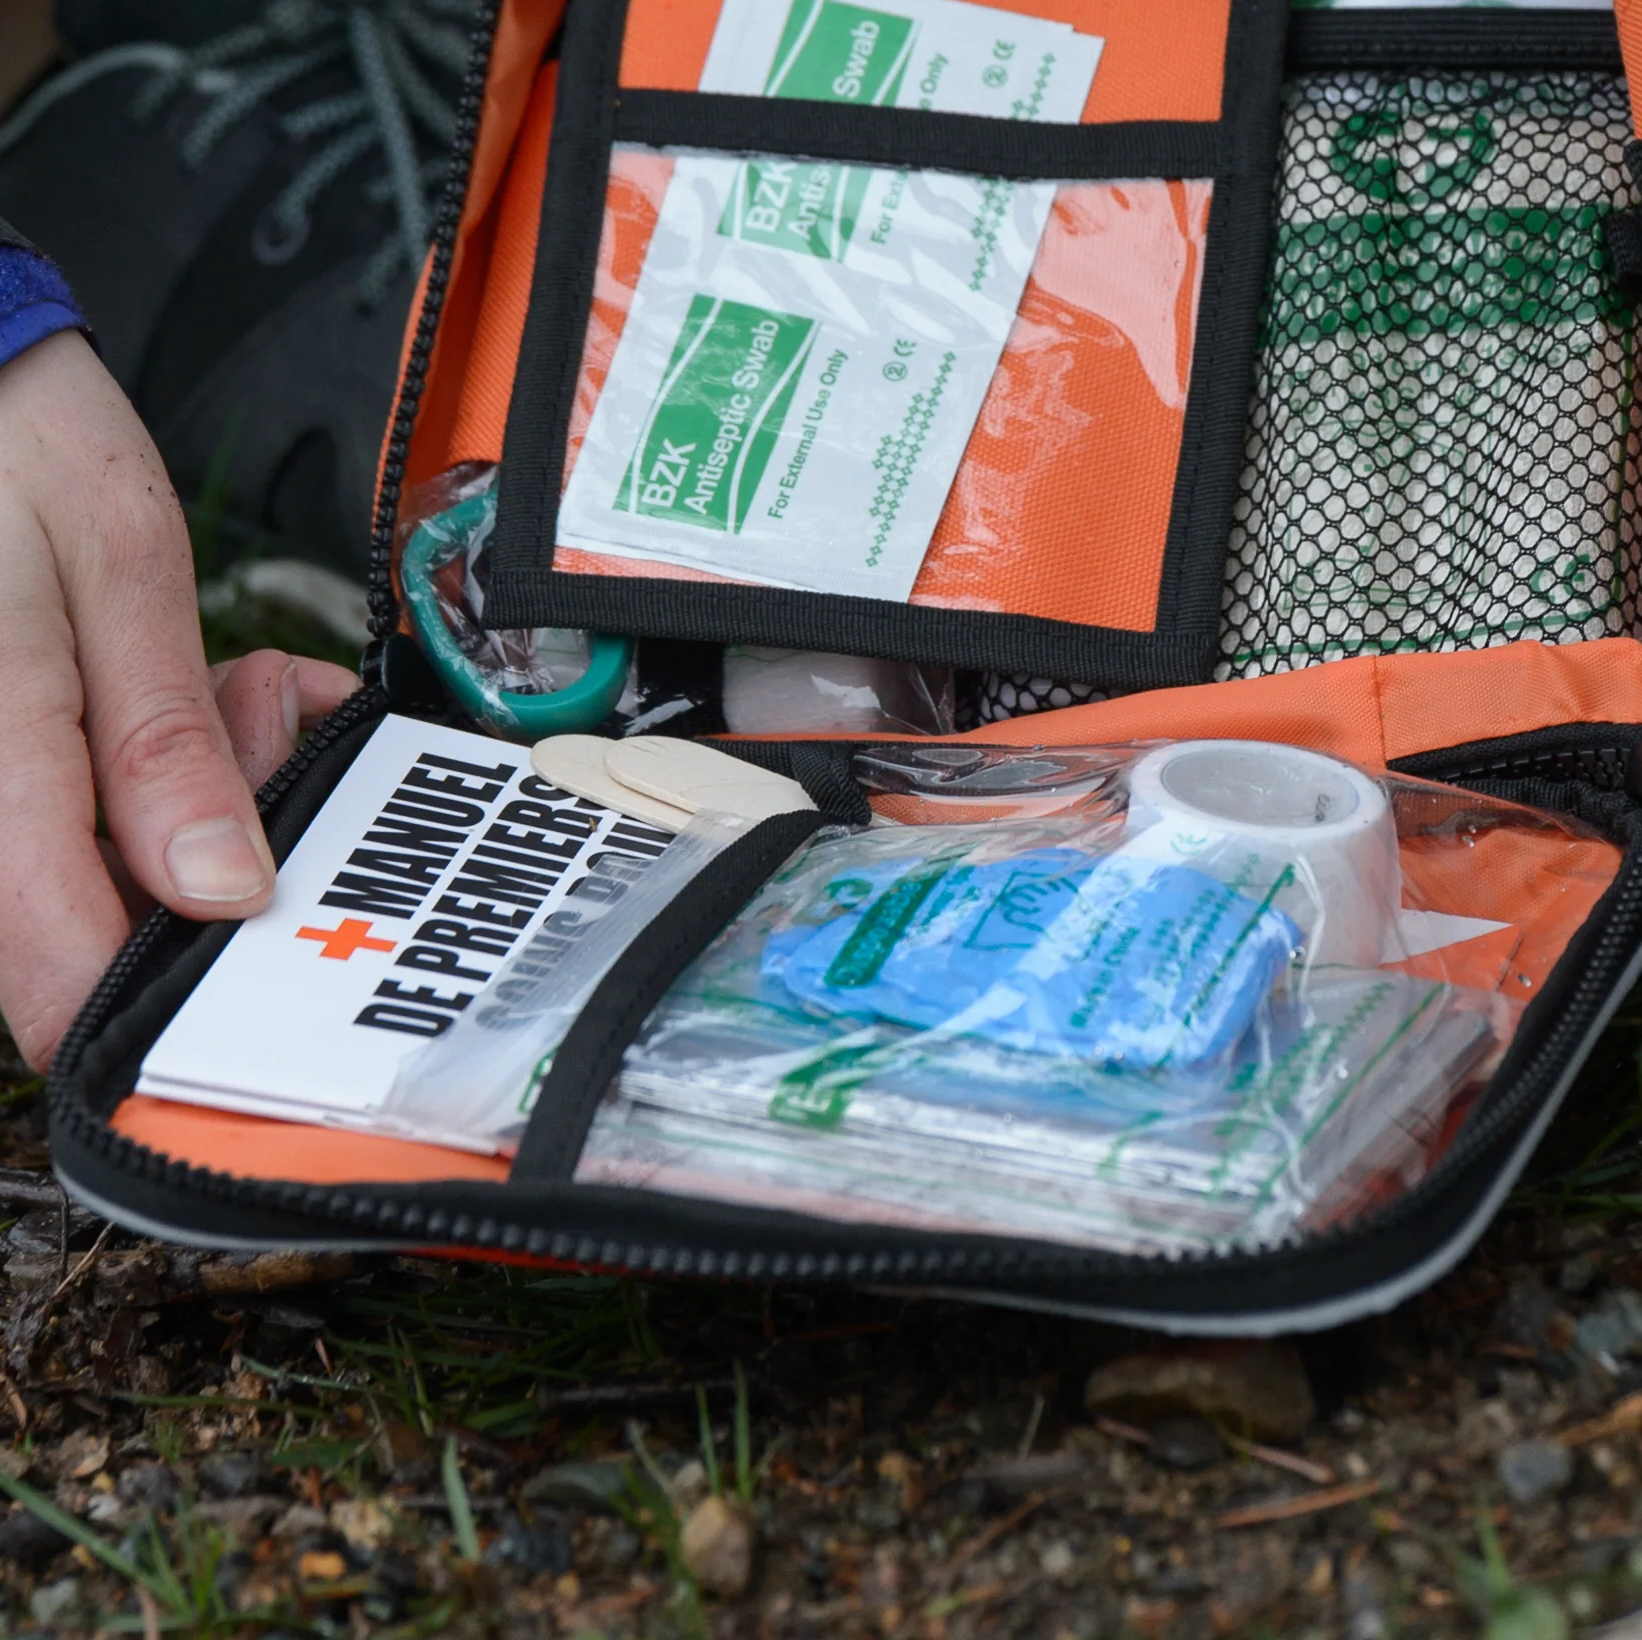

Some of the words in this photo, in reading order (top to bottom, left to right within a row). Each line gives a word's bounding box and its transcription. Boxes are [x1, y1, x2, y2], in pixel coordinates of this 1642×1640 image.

[746, 159, 796, 232] BZK
[788, 169, 832, 241] Antis
[831, 21, 881, 99] Swab
[871, 213, 894, 244] For
[922, 51, 950, 95] Only
[641, 438, 697, 507] BZK
[683, 394, 752, 516] Antiseptic
[732, 319, 780, 390] Swab
[767, 490, 791, 518] For
[779, 426, 818, 490] External
[806, 389, 831, 421] Use
[819, 348, 848, 387] Only
[318, 751, 518, 920] MANUEL
[394, 773, 607, 982] PREMIERS
[353, 977, 474, 1038] DE
